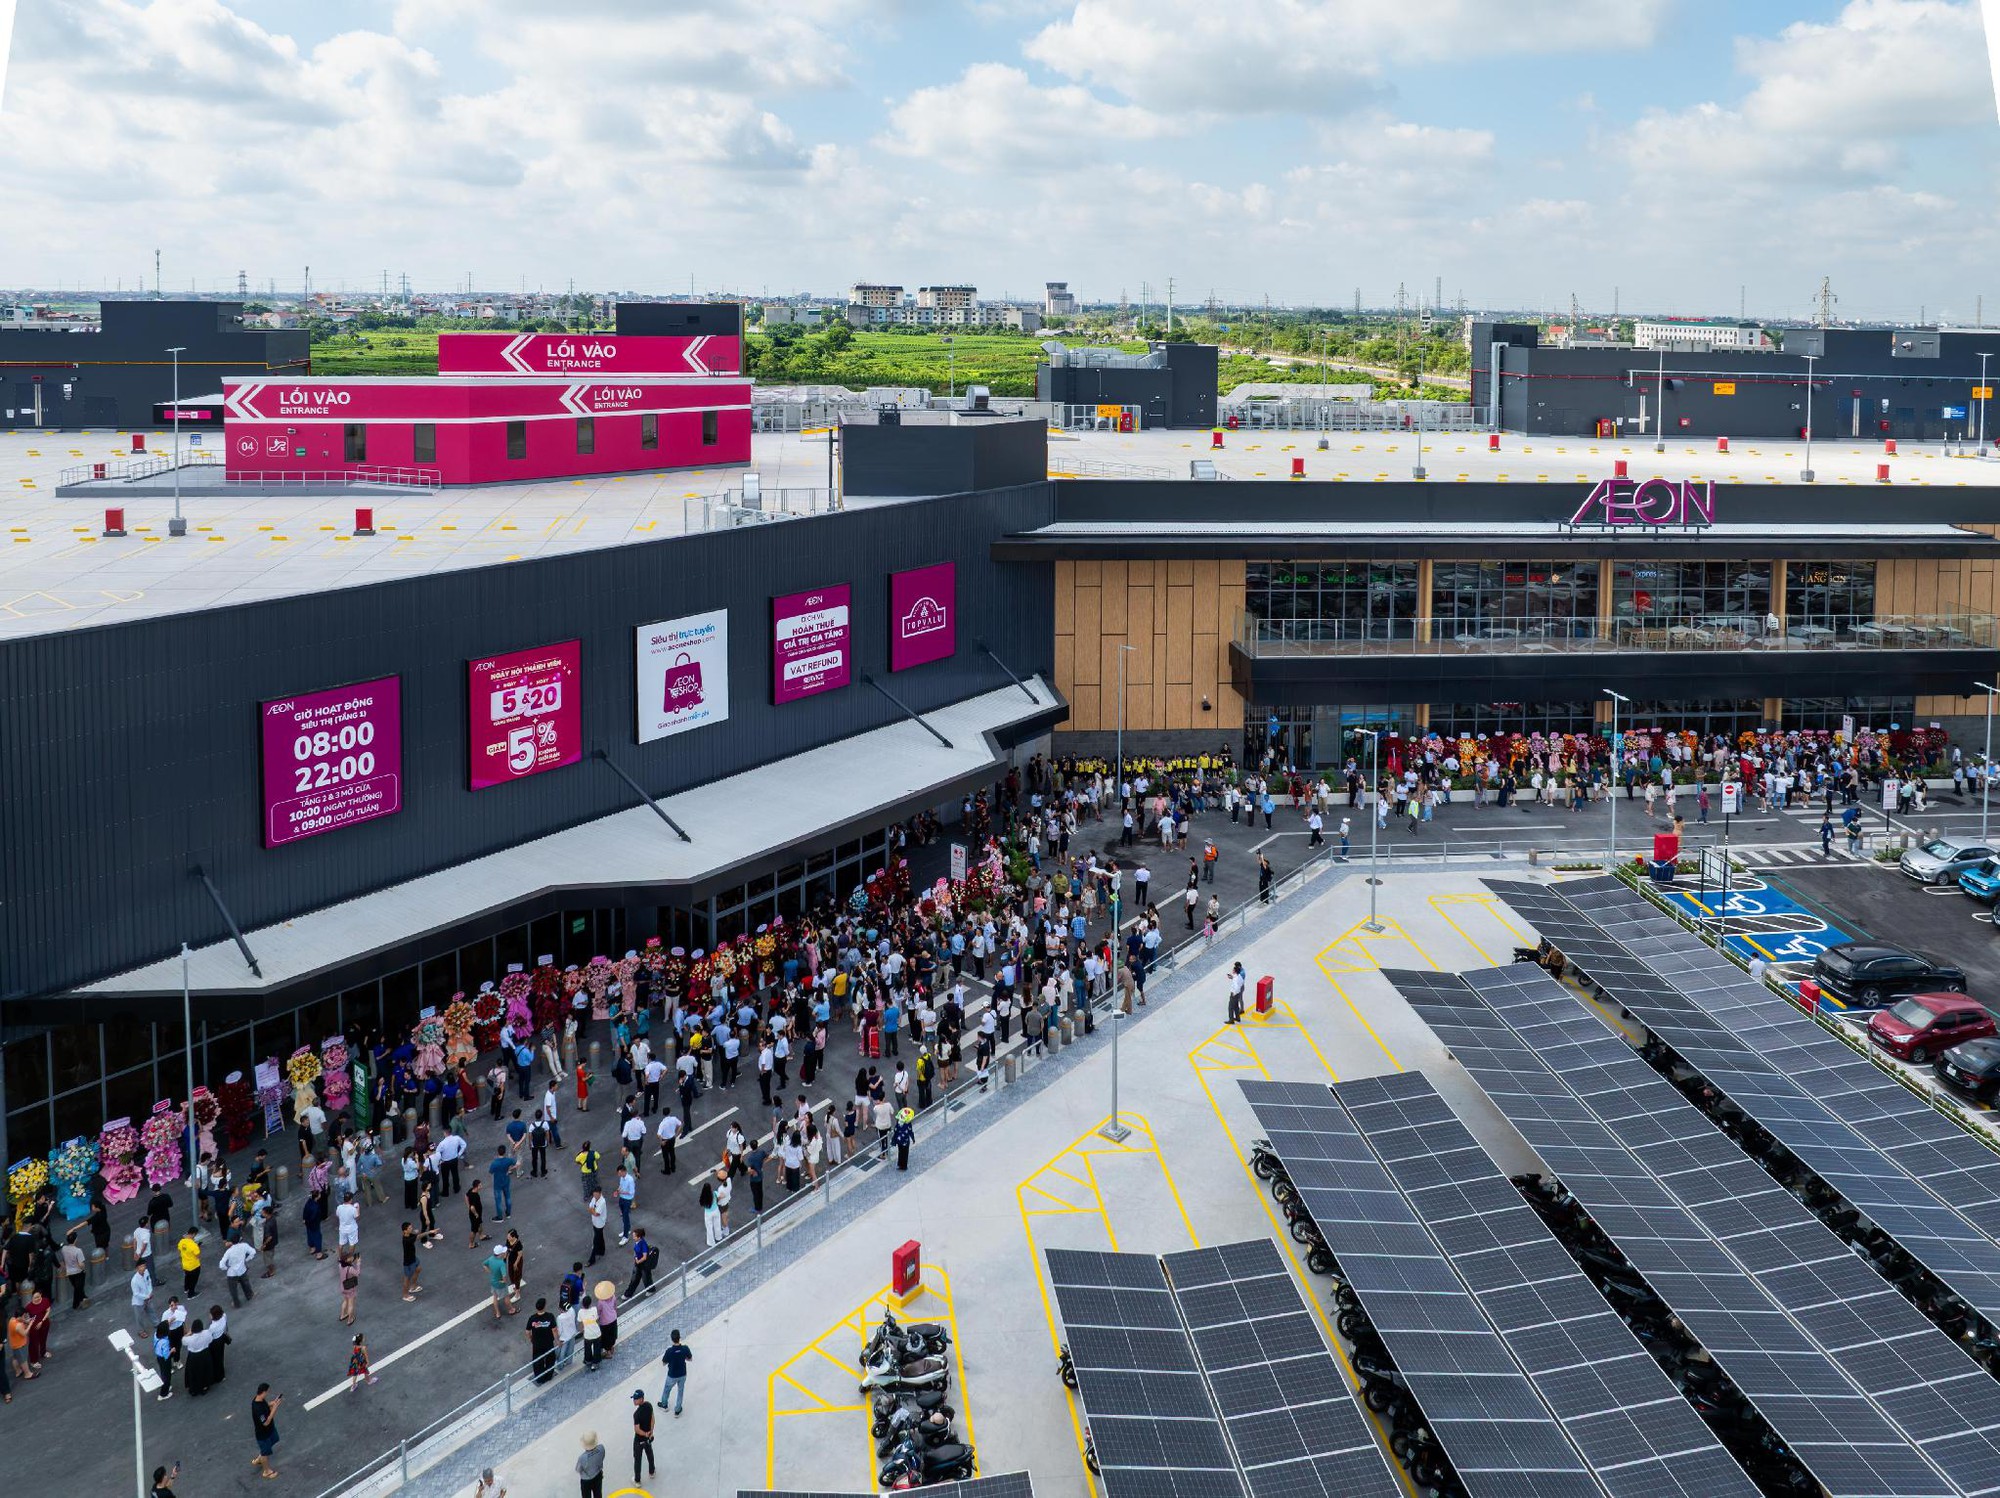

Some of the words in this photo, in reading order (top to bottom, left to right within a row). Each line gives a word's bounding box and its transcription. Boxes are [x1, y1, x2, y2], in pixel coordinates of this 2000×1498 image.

[547, 340, 575, 358] LỐI
[582, 342, 616, 358] VÀO
[547, 360, 600, 368] ENTRANCE
[280, 387, 308, 404] LỐI
[314, 389, 350, 404] VÀO
[594, 387, 614, 400] LỐI
[617, 387, 642, 400] VÀO
[280, 406, 328, 414] ENTRANCE
[241, 442, 254, 451] 04
[908, 615, 942, 630] TOPVALU
[784, 638, 796, 650] GIÁ
[798, 637, 810, 646] TRỊ
[810, 634, 823, 642] GIA
[790, 664, 807, 675] VAT
[808, 656, 838, 670] REFUND
[502, 690, 516, 712] 5
[522, 693, 530, 704] &
[530, 686, 557, 710] 20
[294, 708, 312, 721] GIỜ
[315, 704, 342, 716] HOẠT
[344, 698, 373, 710] ĐỘNG
[301, 720, 318, 730] SIÊU
[294, 721, 374, 760] 08:00
[294, 752, 375, 792] 22:00
[290, 806, 320, 822] 10:00
[302, 815, 332, 830] 09:00
